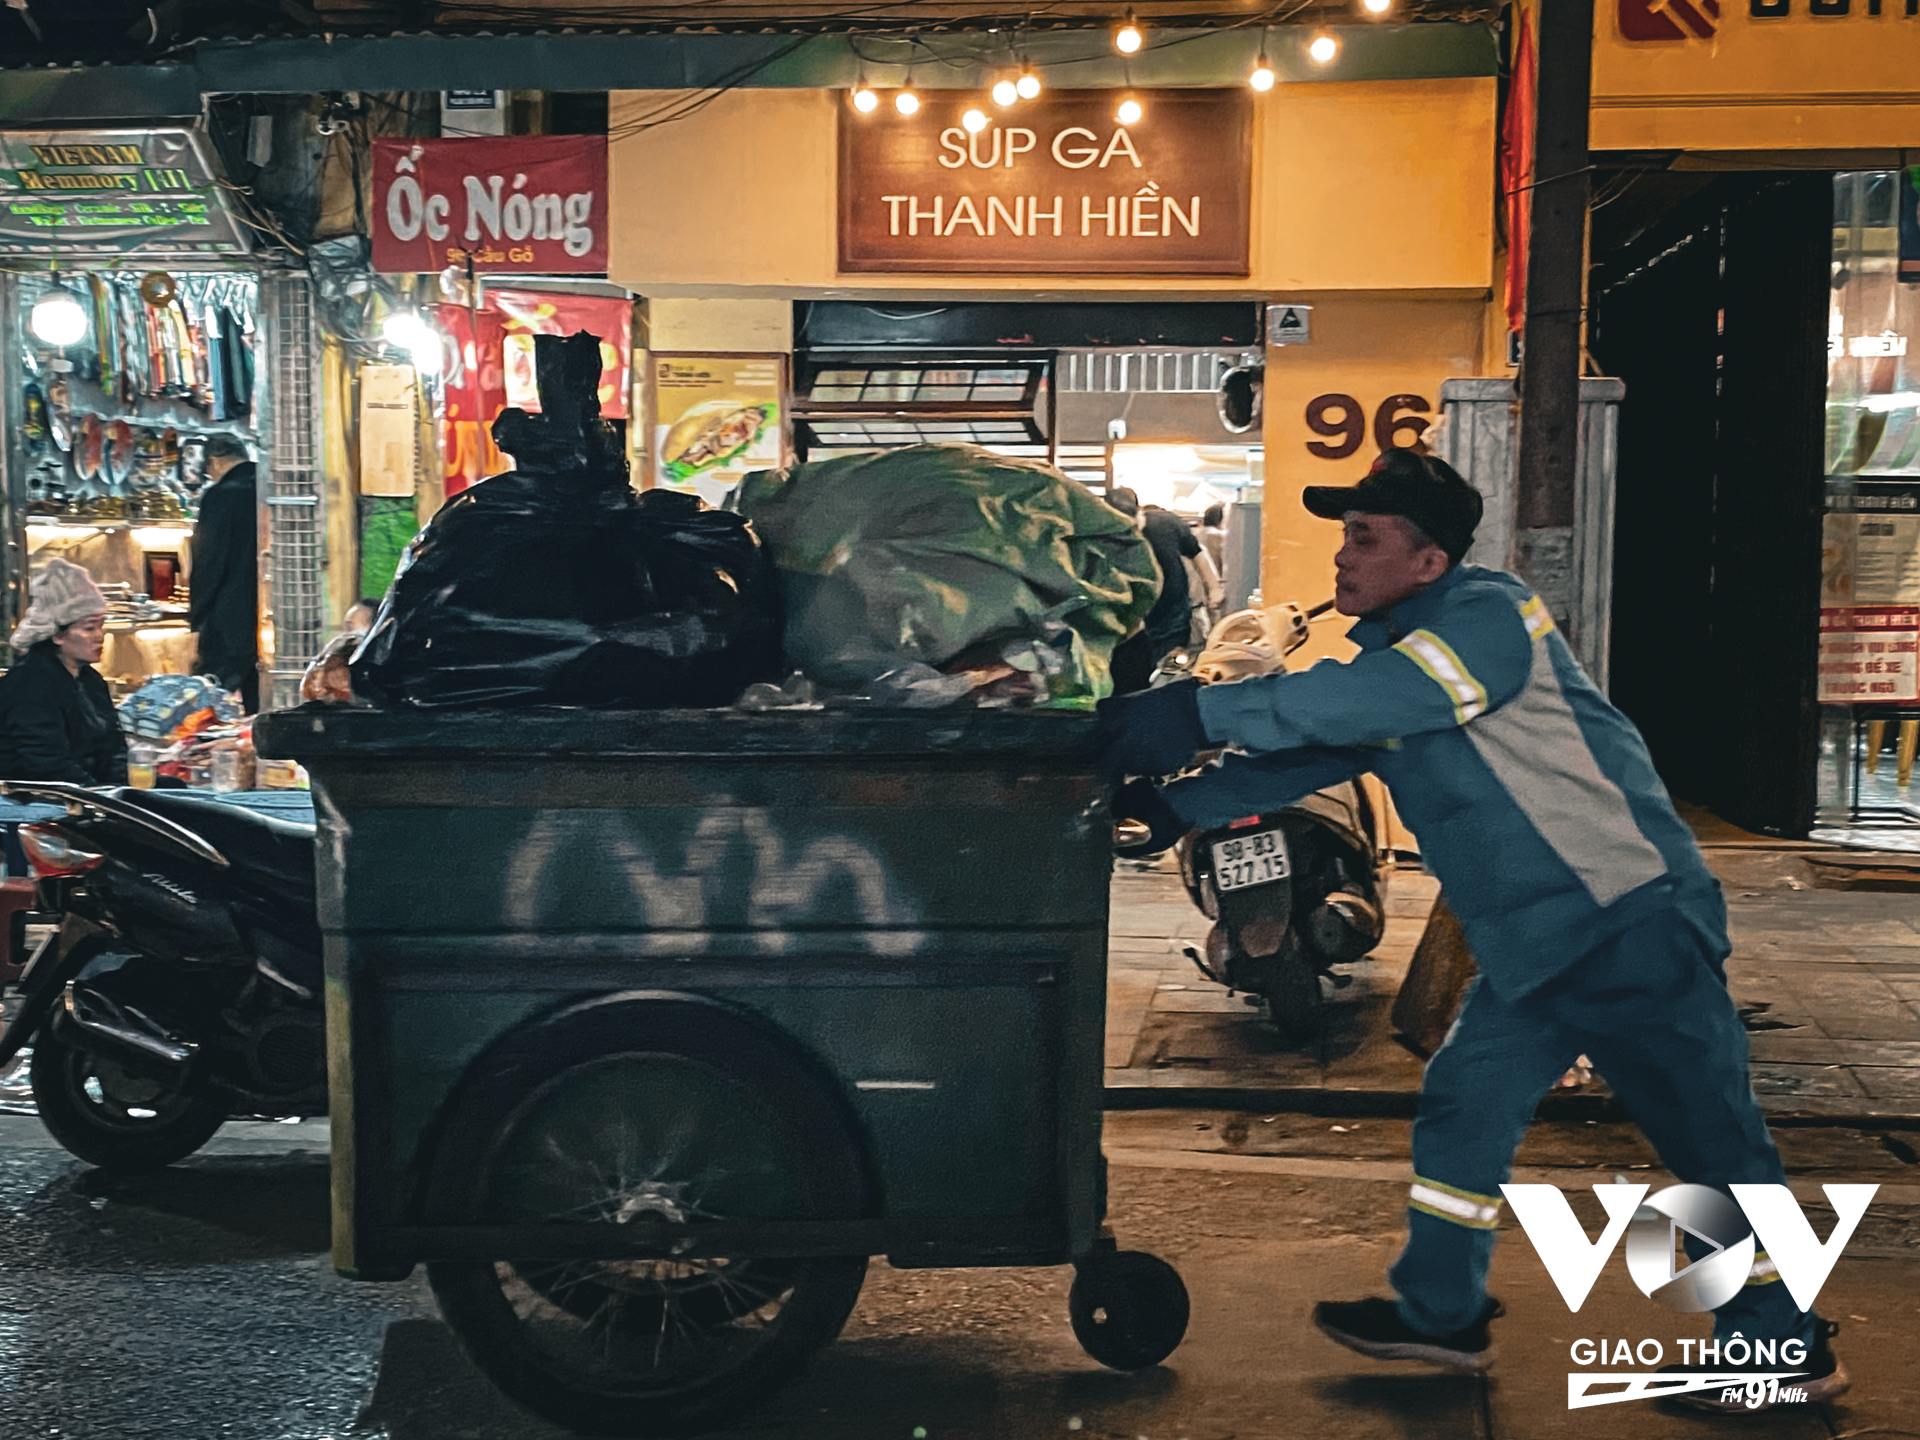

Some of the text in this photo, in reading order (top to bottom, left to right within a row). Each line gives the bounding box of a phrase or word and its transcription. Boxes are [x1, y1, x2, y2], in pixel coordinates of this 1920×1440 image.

[387, 145, 594, 257] Ốc Nóng
[881, 181, 1200, 236] THANH HIỀN
[1306, 393, 1431, 459] 96
